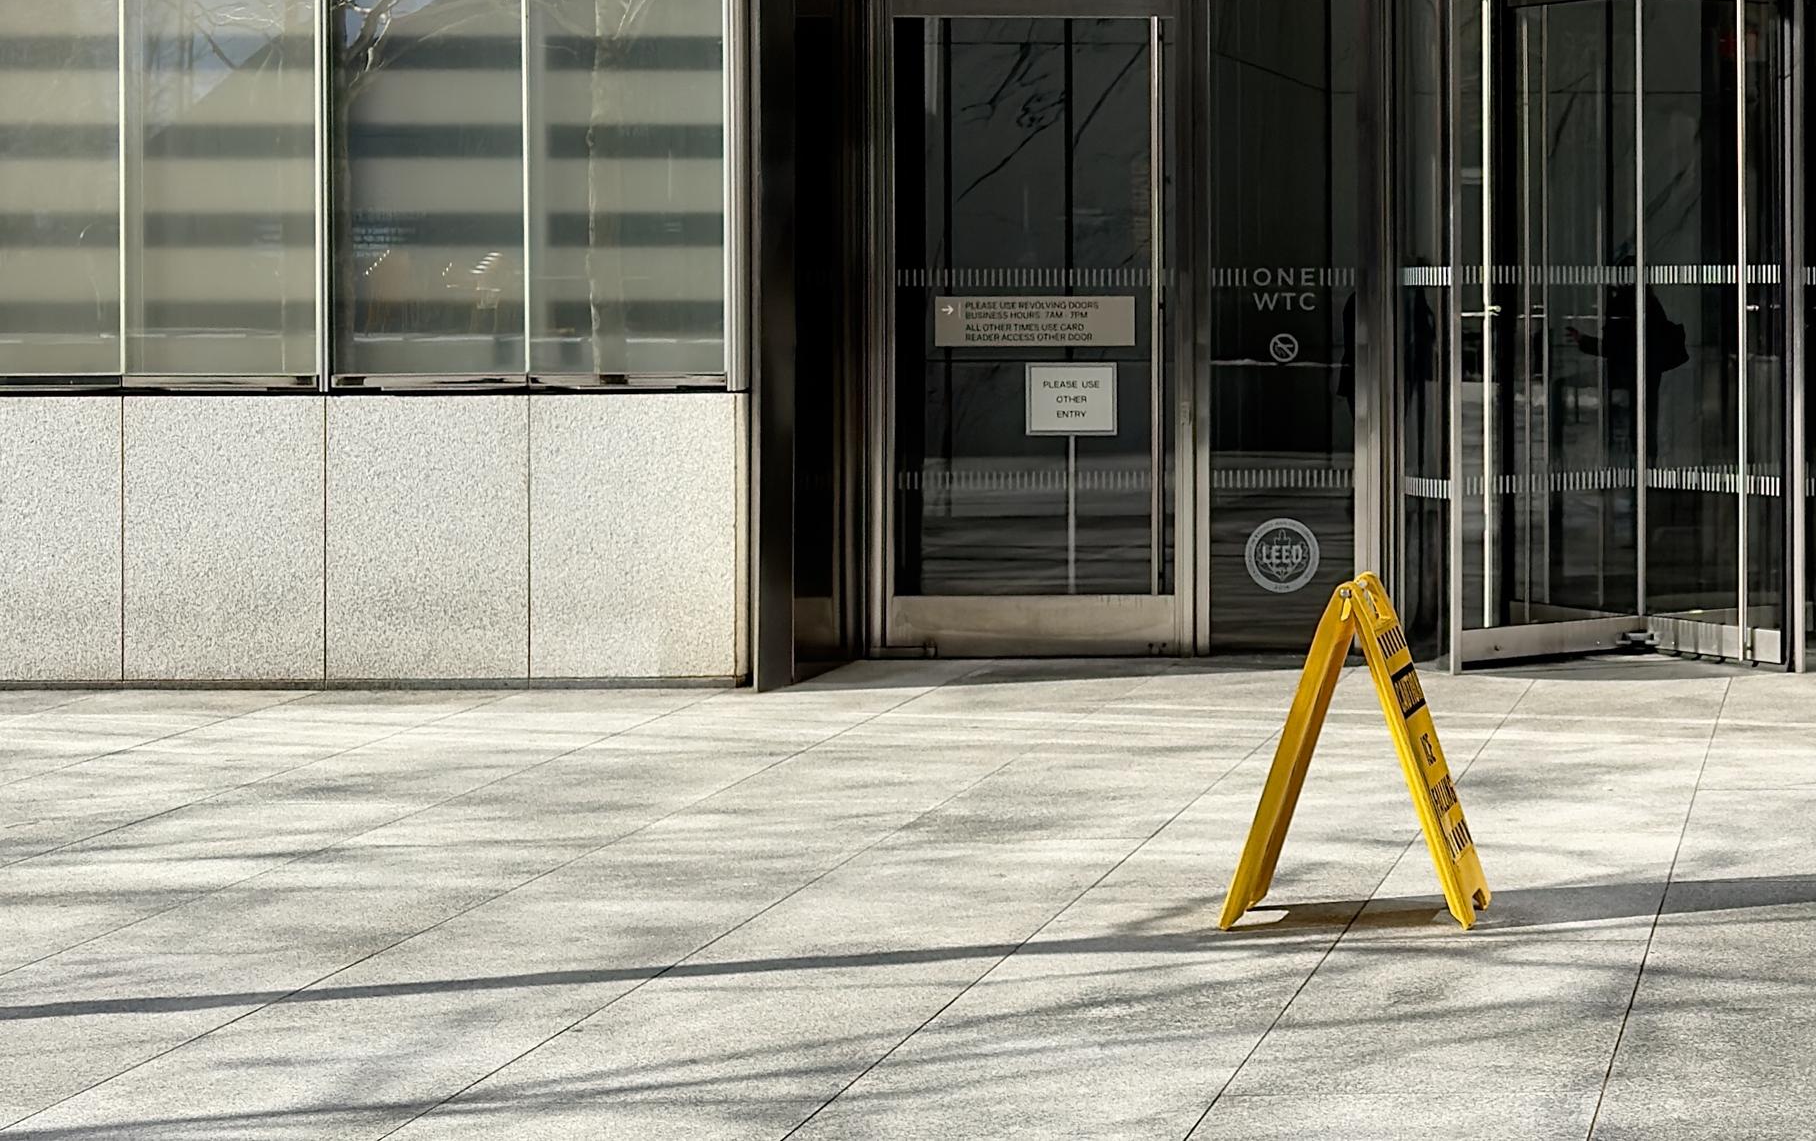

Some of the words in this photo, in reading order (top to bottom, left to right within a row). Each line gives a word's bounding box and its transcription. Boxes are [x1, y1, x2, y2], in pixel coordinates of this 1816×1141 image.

[1252, 267, 1315, 286] ONE
[965, 301, 998, 310] PLEASE
[999, 301, 1016, 310] USE
[1018, 301, 1067, 310] REVOLVING
[1068, 301, 1100, 310] DOORS
[1252, 292, 1316, 311] WTC
[965, 311, 1008, 320] BUSINESS
[965, 323, 981, 332] ALL
[982, 323, 1012, 332] OTHER
[1013, 323, 1040, 332] TIMES
[1041, 323, 1058, 332] USE
[1060, 323, 1084, 332] CARD
[965, 333, 1000, 342] READER
[1001, 333, 1035, 342] ACCESS
[1037, 333, 1066, 342] OTHER
[1068, 333, 1093, 342] DOOR
[1043, 380, 1078, 389] PLEASE
[1081, 380, 1100, 389] USE
[1056, 395, 1087, 404] OTHER
[1056, 410, 1087, 418] ENTRY
[1262, 545, 1303, 563] LEED
